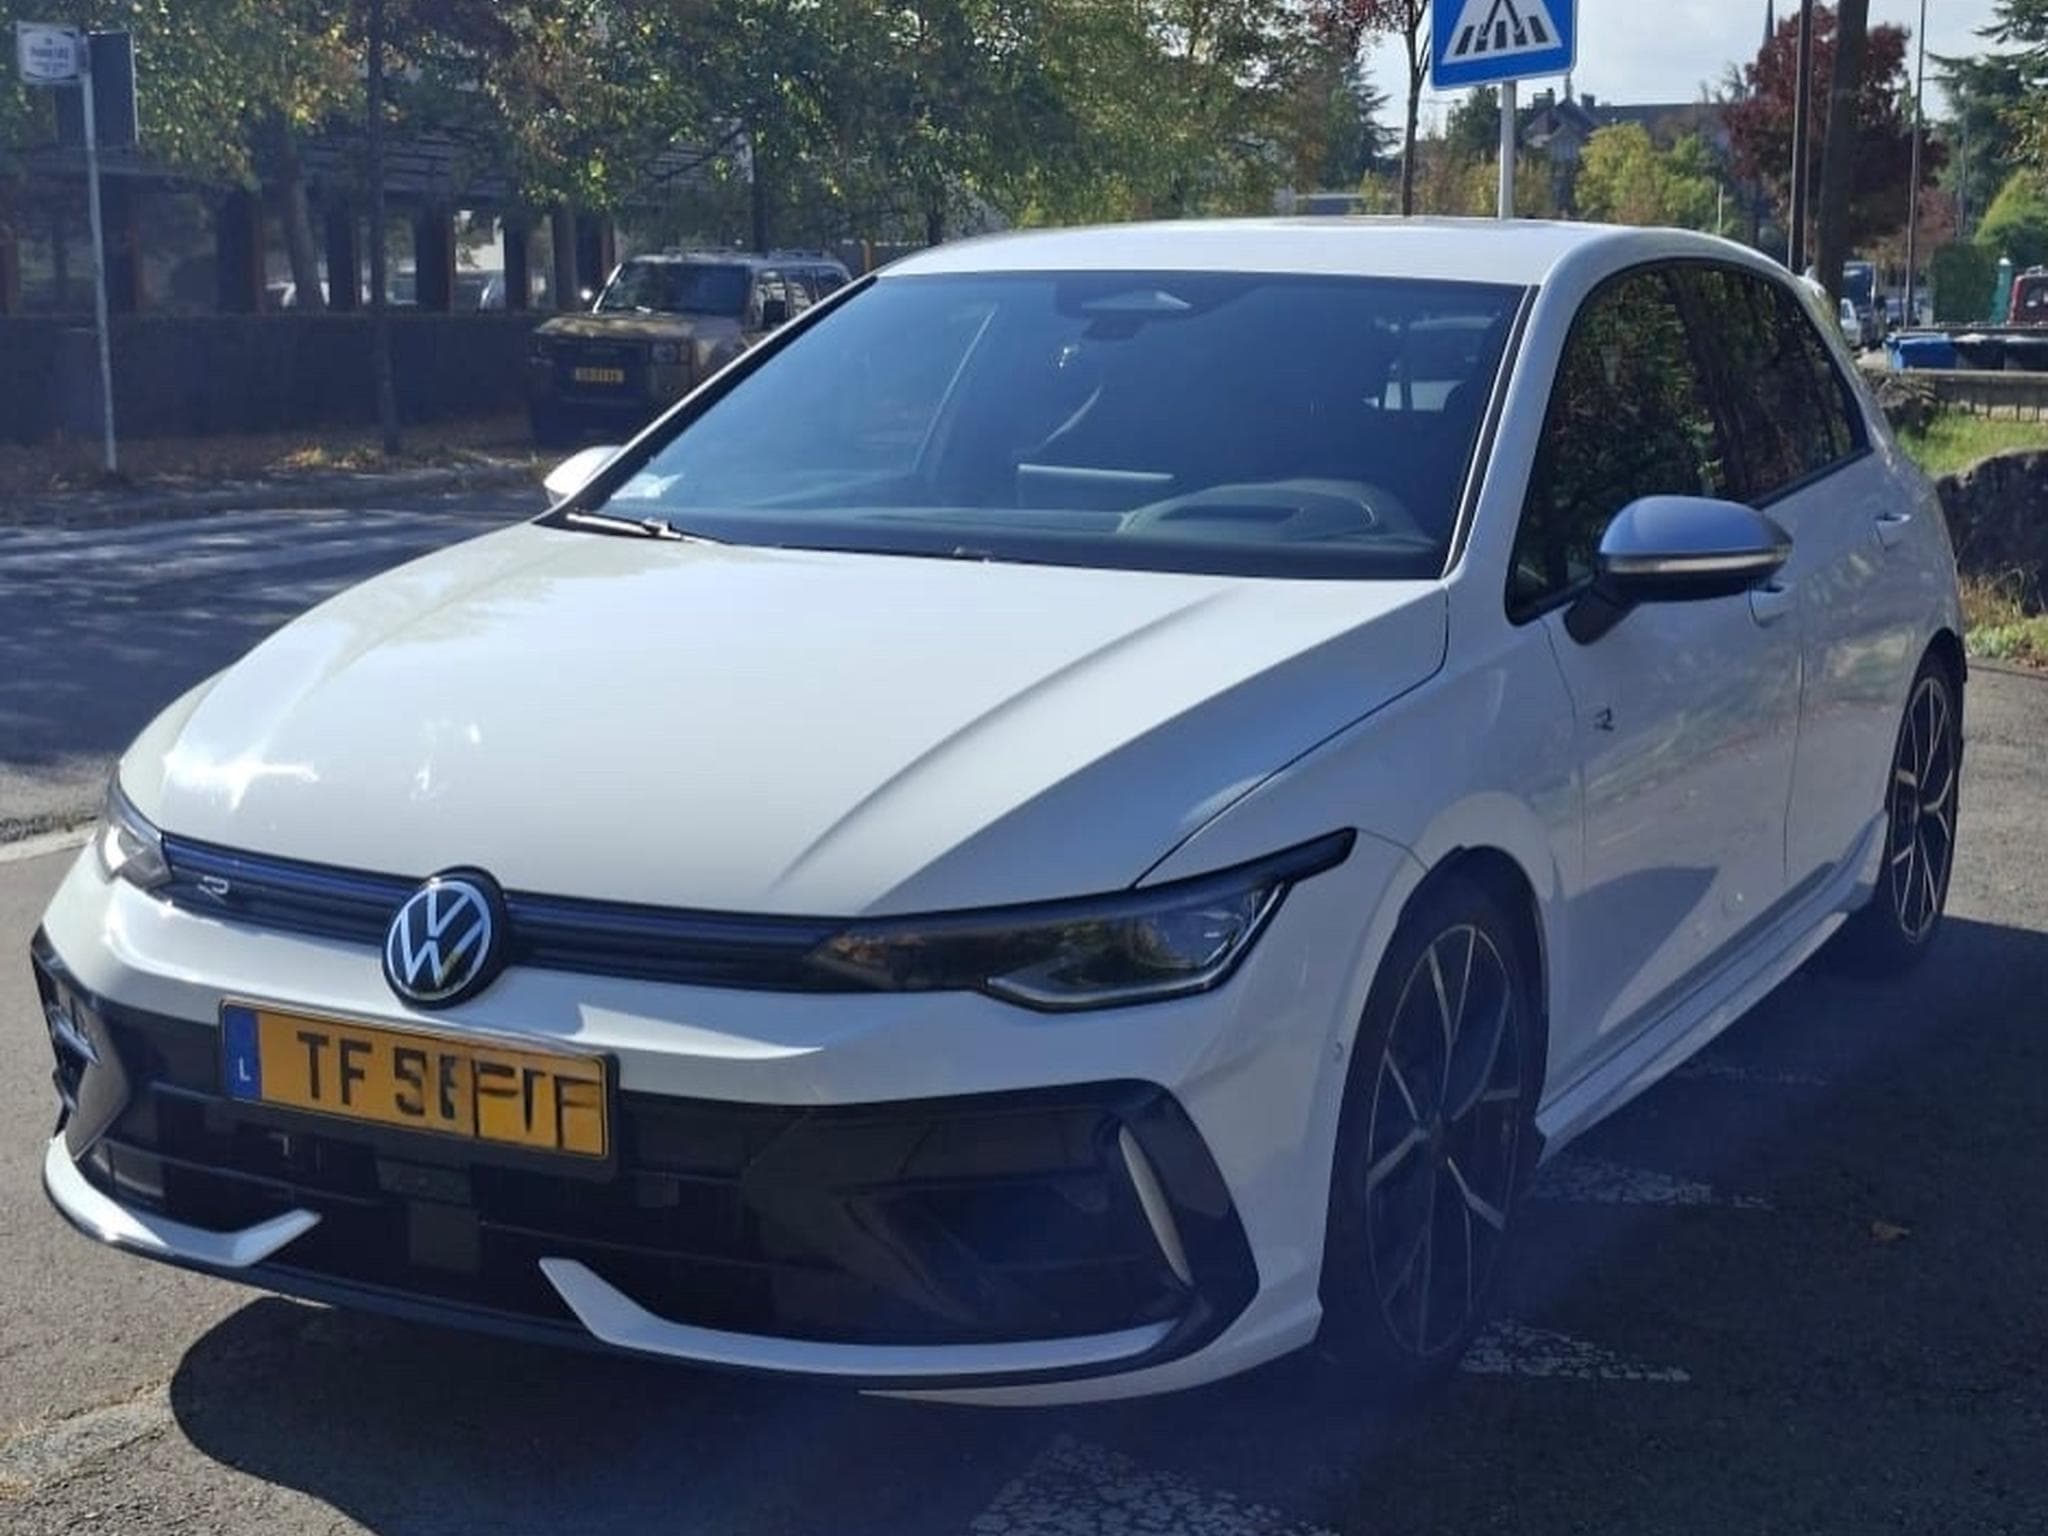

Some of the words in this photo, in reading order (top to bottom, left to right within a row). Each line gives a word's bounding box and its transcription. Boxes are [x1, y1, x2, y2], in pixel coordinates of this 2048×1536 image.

[394, 882, 488, 994] VW
[238, 1056, 251, 1081] L
[297, 1030, 372, 1105] TF
